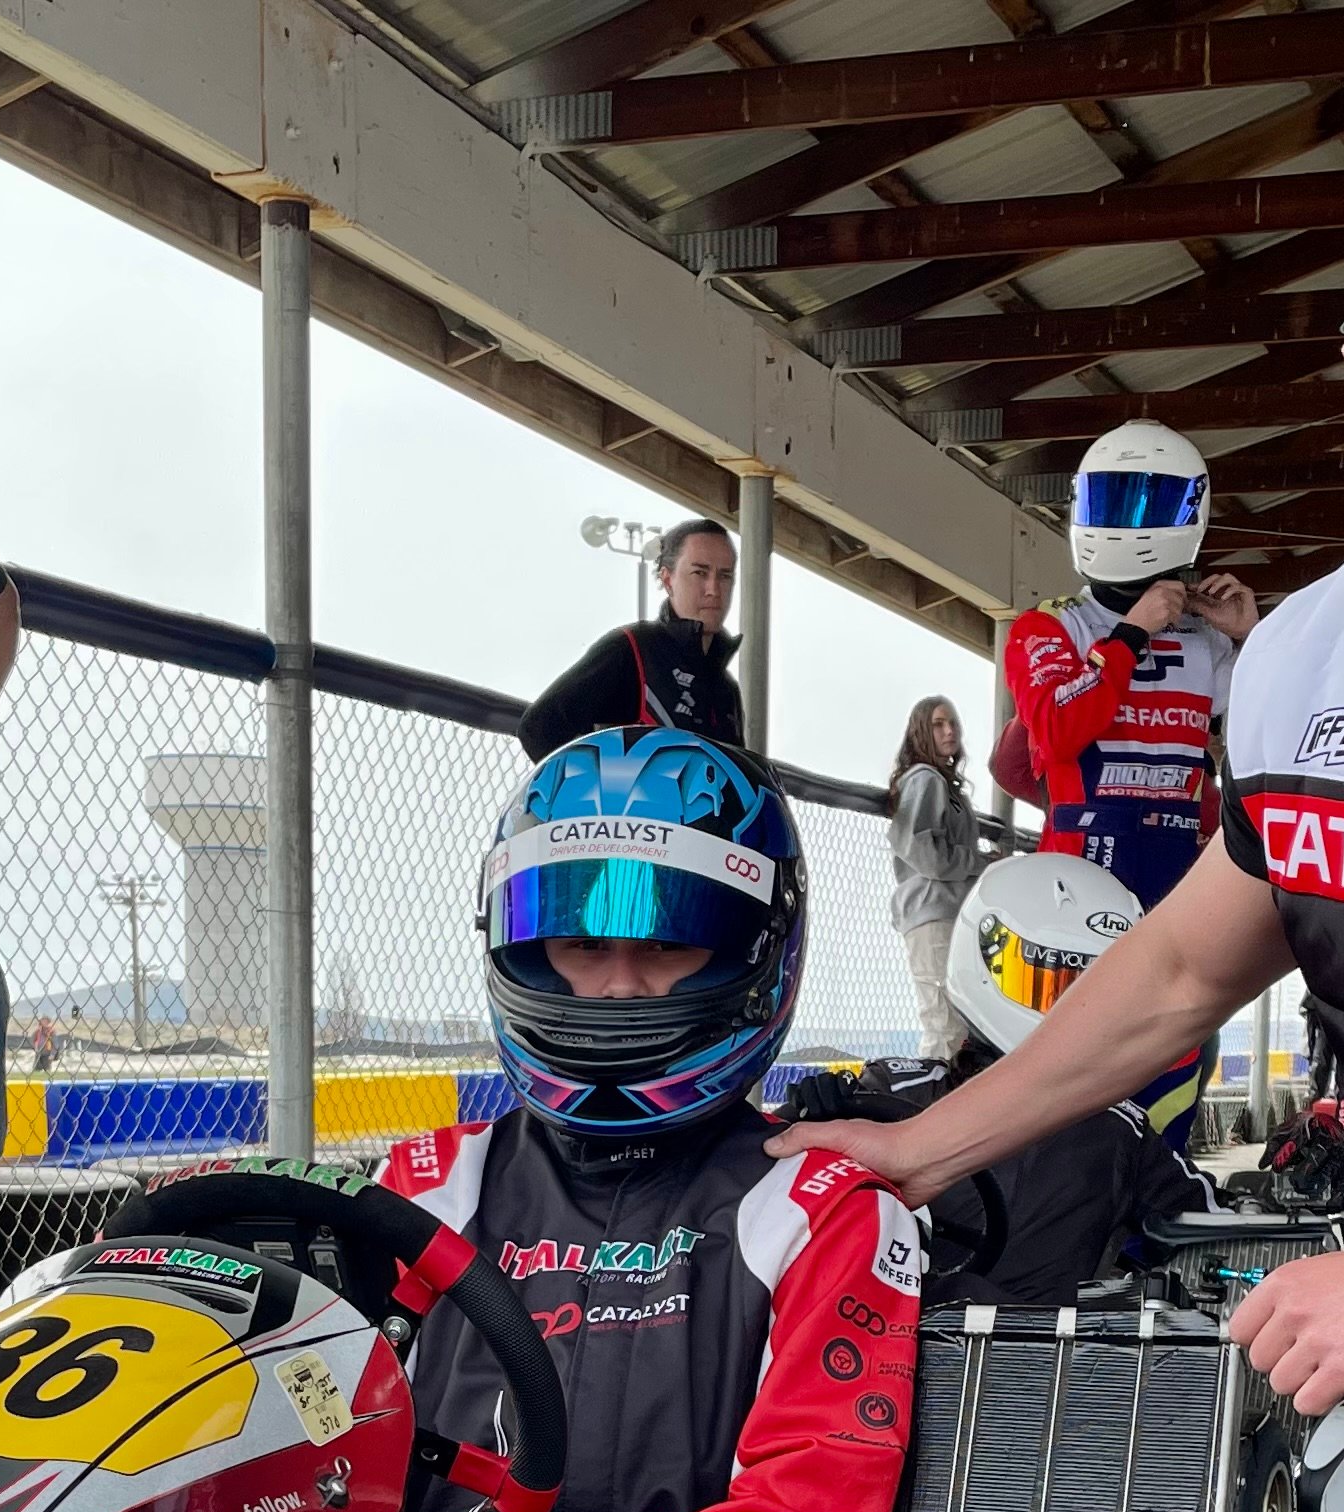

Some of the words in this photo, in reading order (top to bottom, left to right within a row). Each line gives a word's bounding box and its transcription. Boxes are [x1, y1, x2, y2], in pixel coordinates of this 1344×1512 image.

[1099, 765, 1193, 790] MIDNIGHT
[549, 821, 674, 845] CATALYST
[549, 844, 587, 857] DRIVER
[588, 843, 670, 859] DEVELOPMENT
[1024, 944, 1058, 963] LIVE
[144, 1155, 377, 1198] ITALKART
[94, 1247, 264, 1280] ITALKART
[498, 1225, 705, 1281] ITALKART
[878, 1257, 921, 1287] OFFSET
[586, 1294, 690, 1324] CATALYST
